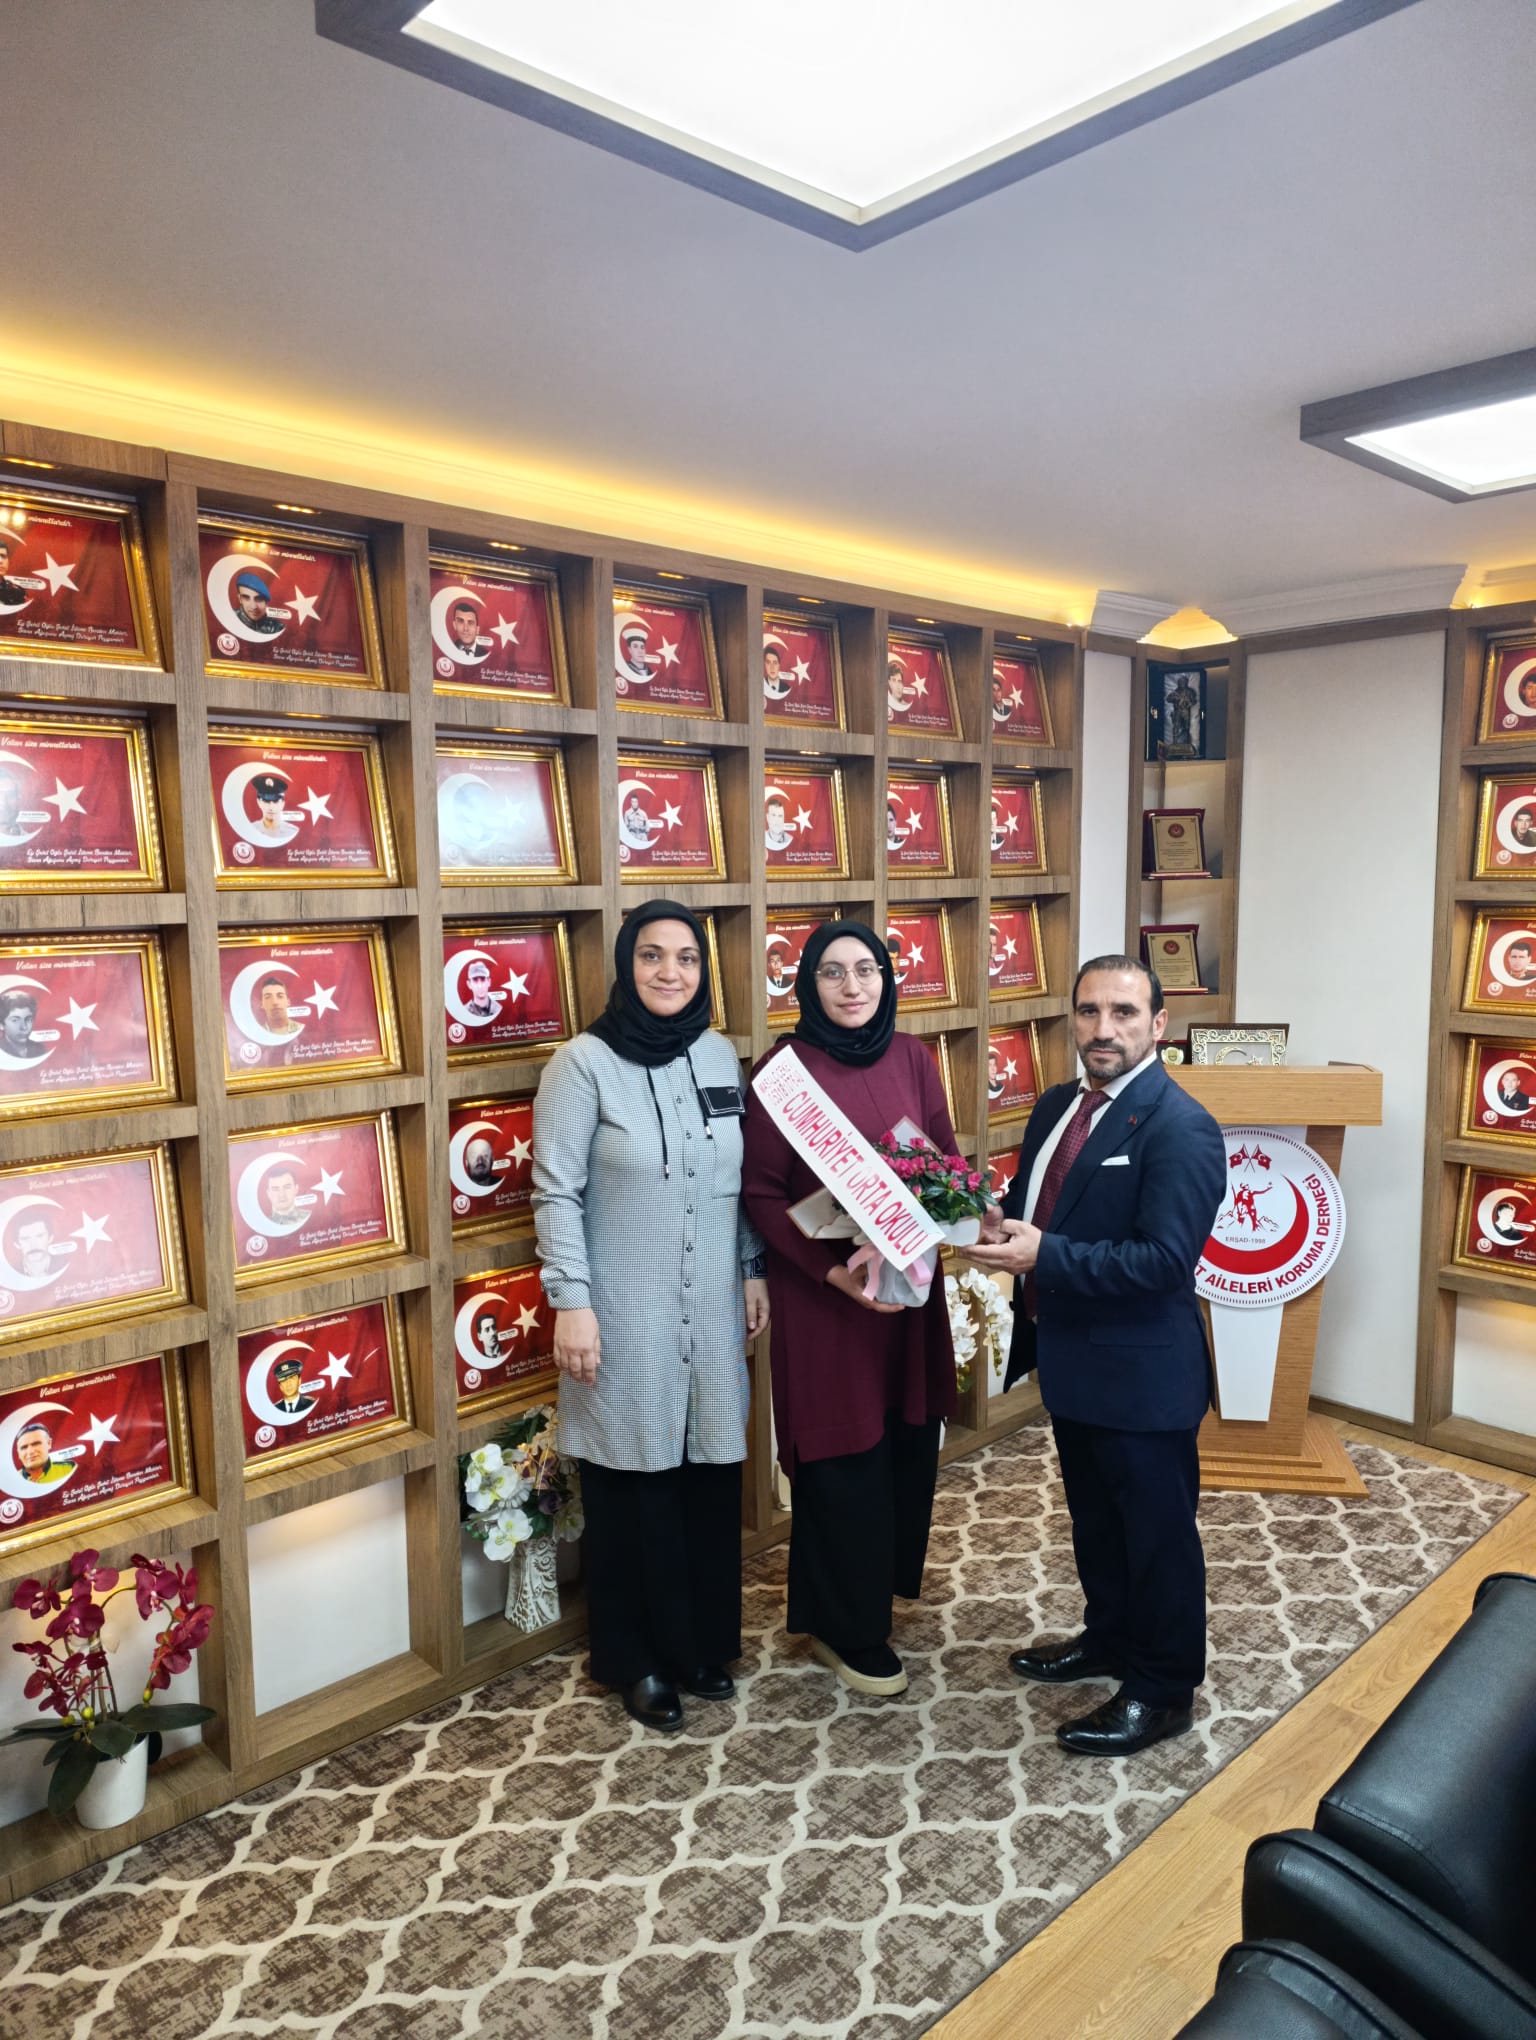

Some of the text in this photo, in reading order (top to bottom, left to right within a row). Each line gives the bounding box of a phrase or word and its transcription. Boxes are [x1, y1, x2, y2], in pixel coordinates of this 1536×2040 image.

[782, 1090, 929, 1256] CUMHURİYET ORTA OKULU
[1204, 1273, 1273, 1294] AİLELERİ
[1275, 1240, 1327, 1289] KORUMA
[1302, 1173, 1331, 1237] DERNEĞİ
